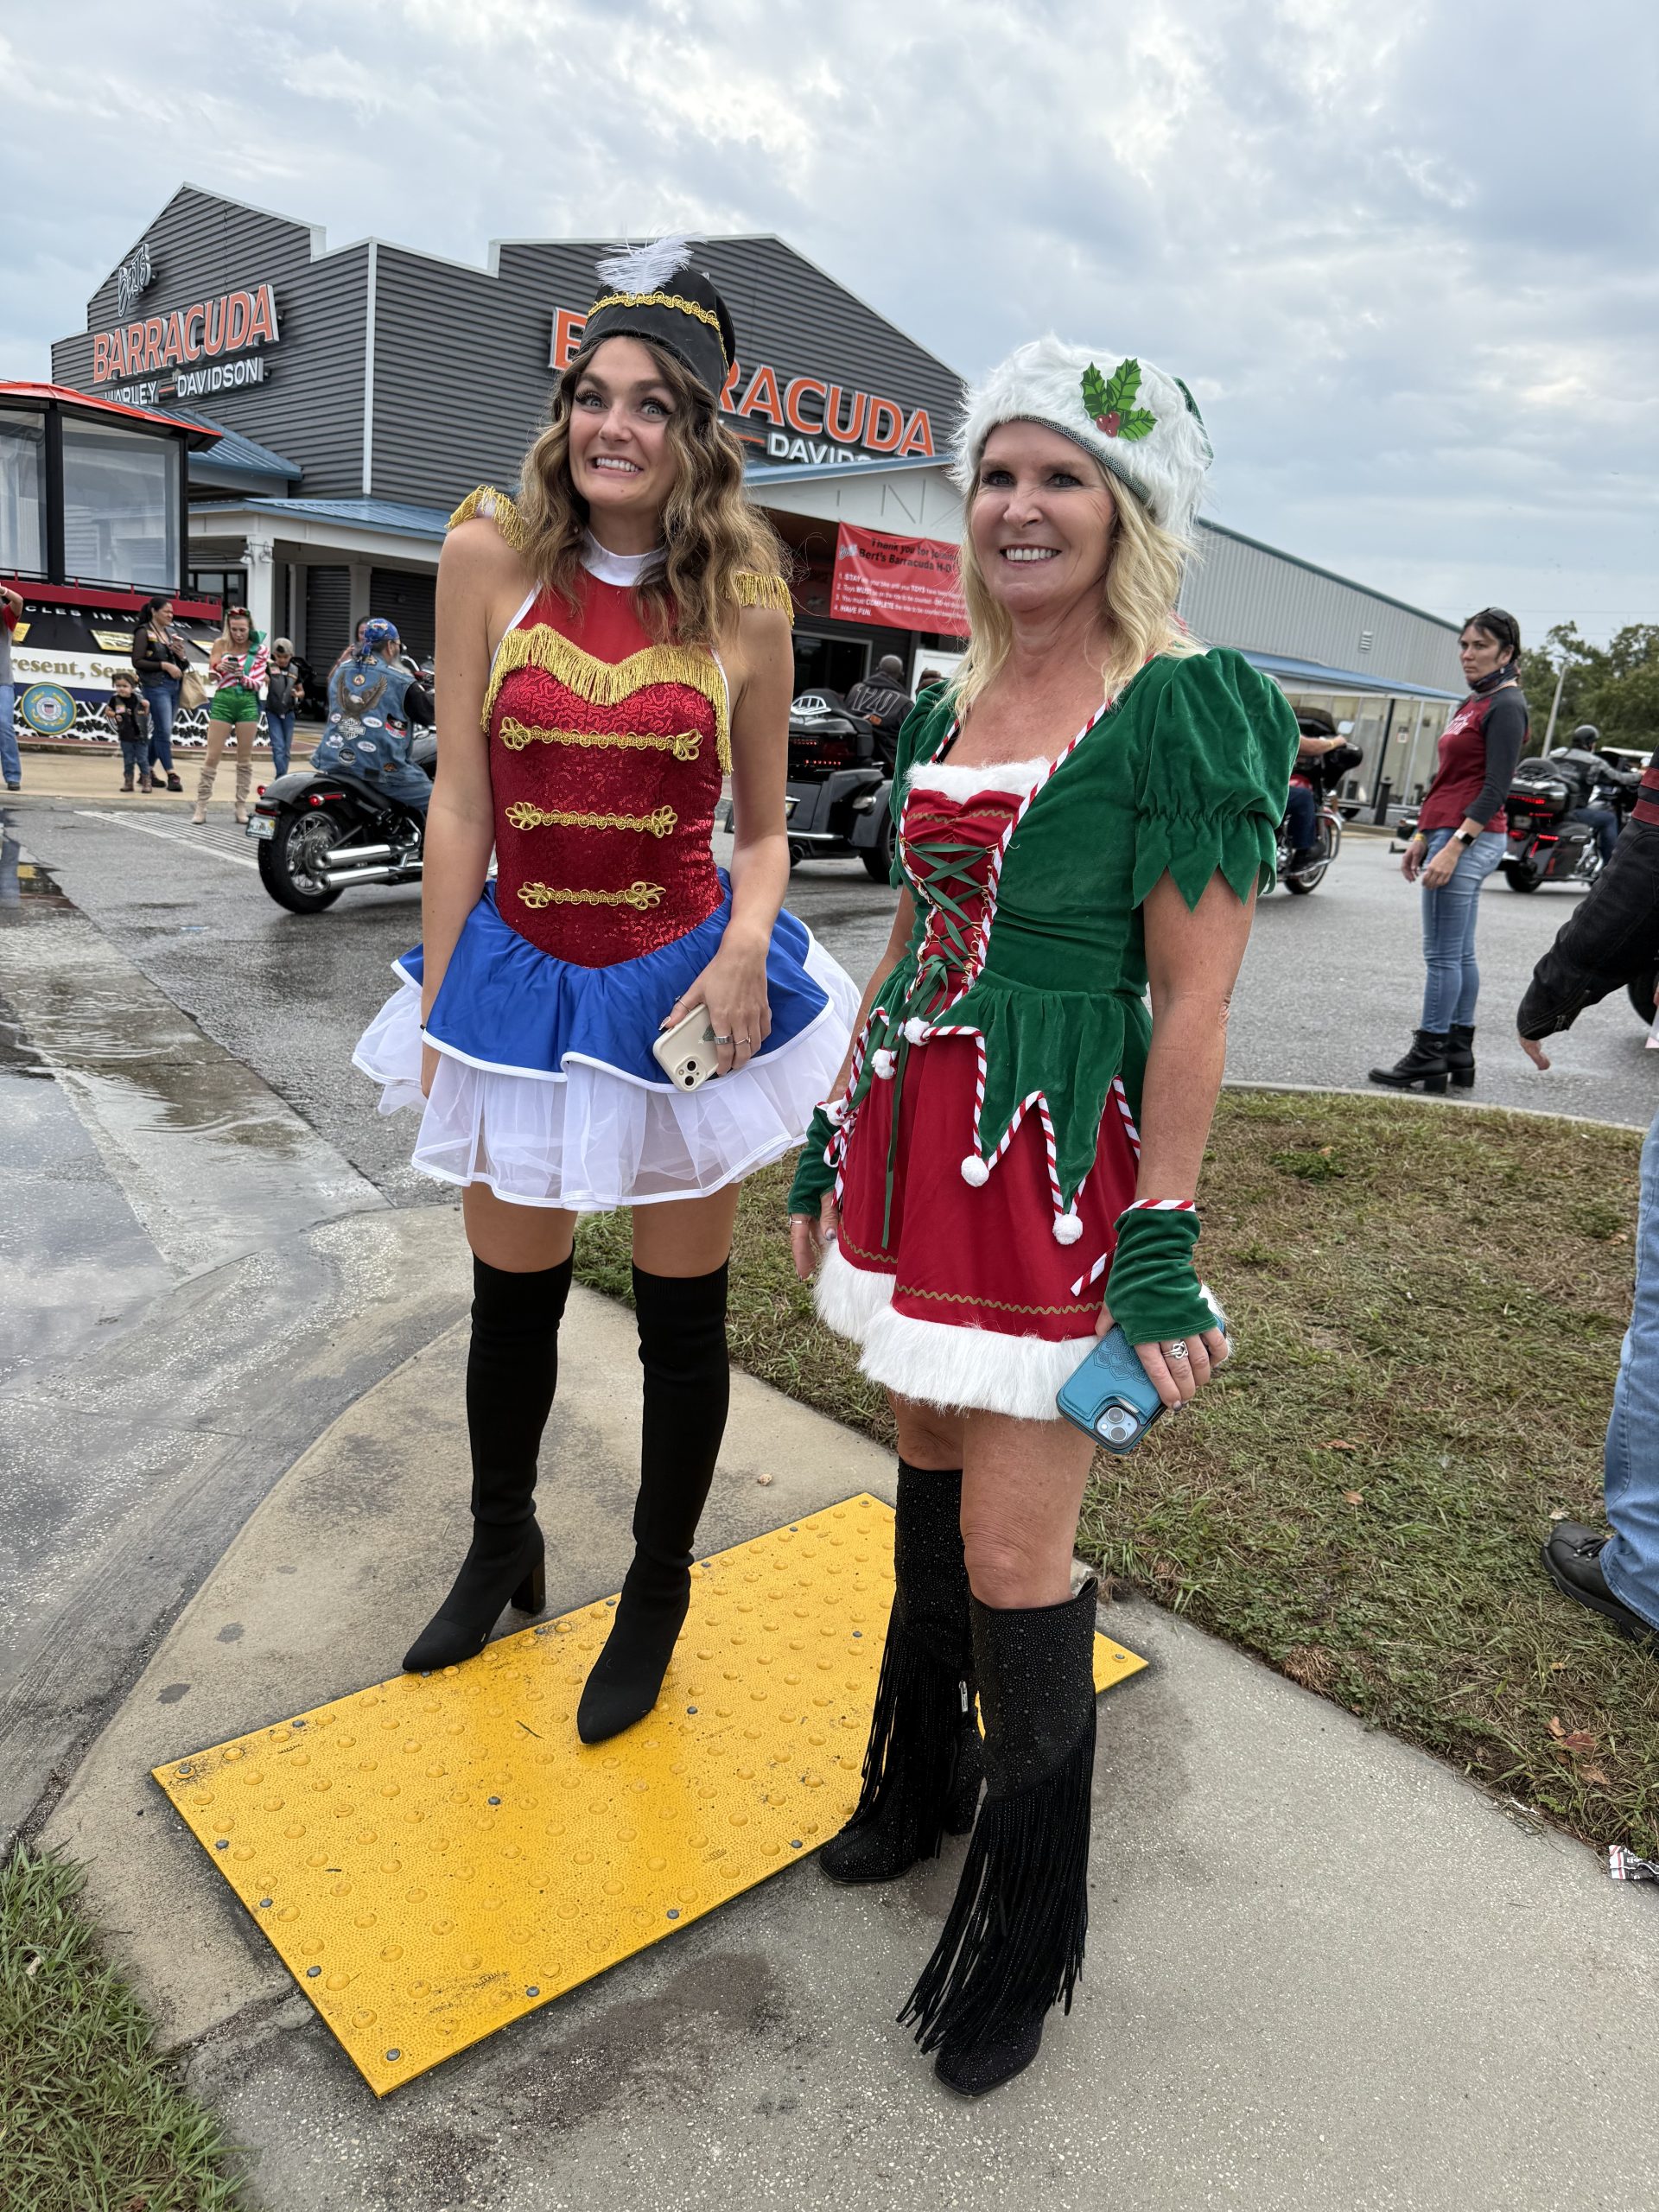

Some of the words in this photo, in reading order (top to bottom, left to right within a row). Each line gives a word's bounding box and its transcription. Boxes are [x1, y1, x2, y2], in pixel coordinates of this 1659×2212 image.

[93, 283, 275, 384] BARRACUDA
[177, 357, 261, 398] DAVIDSON
[549, 306, 936, 458] BACUDA
[768, 432, 873, 464] DAVID
[871, 537, 899, 551] Thank
[900, 544, 915, 555] you
[859, 548, 887, 561] Bert's
[889, 553, 934, 570] Barracuda
[25, 605, 82, 617] CLES
[865, 598, 894, 610] COMPLETE
[11, 658, 86, 679] resent,
